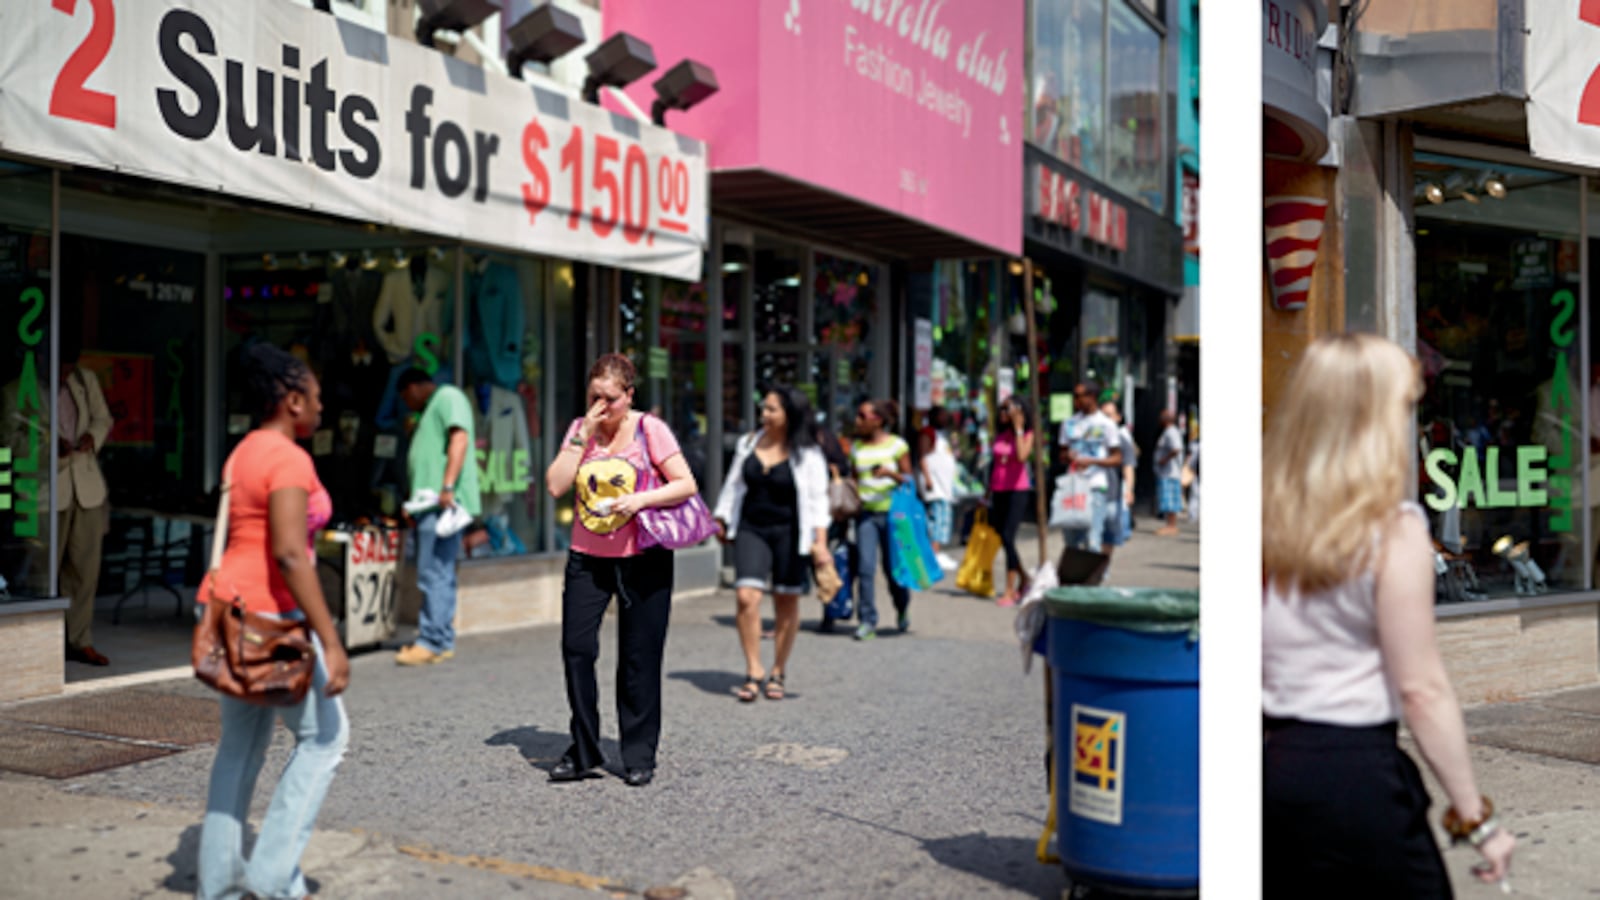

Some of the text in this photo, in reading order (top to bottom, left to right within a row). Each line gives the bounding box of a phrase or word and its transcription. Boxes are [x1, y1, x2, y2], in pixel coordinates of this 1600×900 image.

[845, 24, 914, 100] Fashion
[956, 31, 1012, 96] club
[49, 0, 118, 129] 2
[155, 9, 381, 178] Suits
[405, 84, 499, 202] for
[475, 449, 530, 493] SALE
[1424, 446, 1549, 512] SALE
[351, 529, 398, 565] SALE
[351, 570, 397, 628] $20
